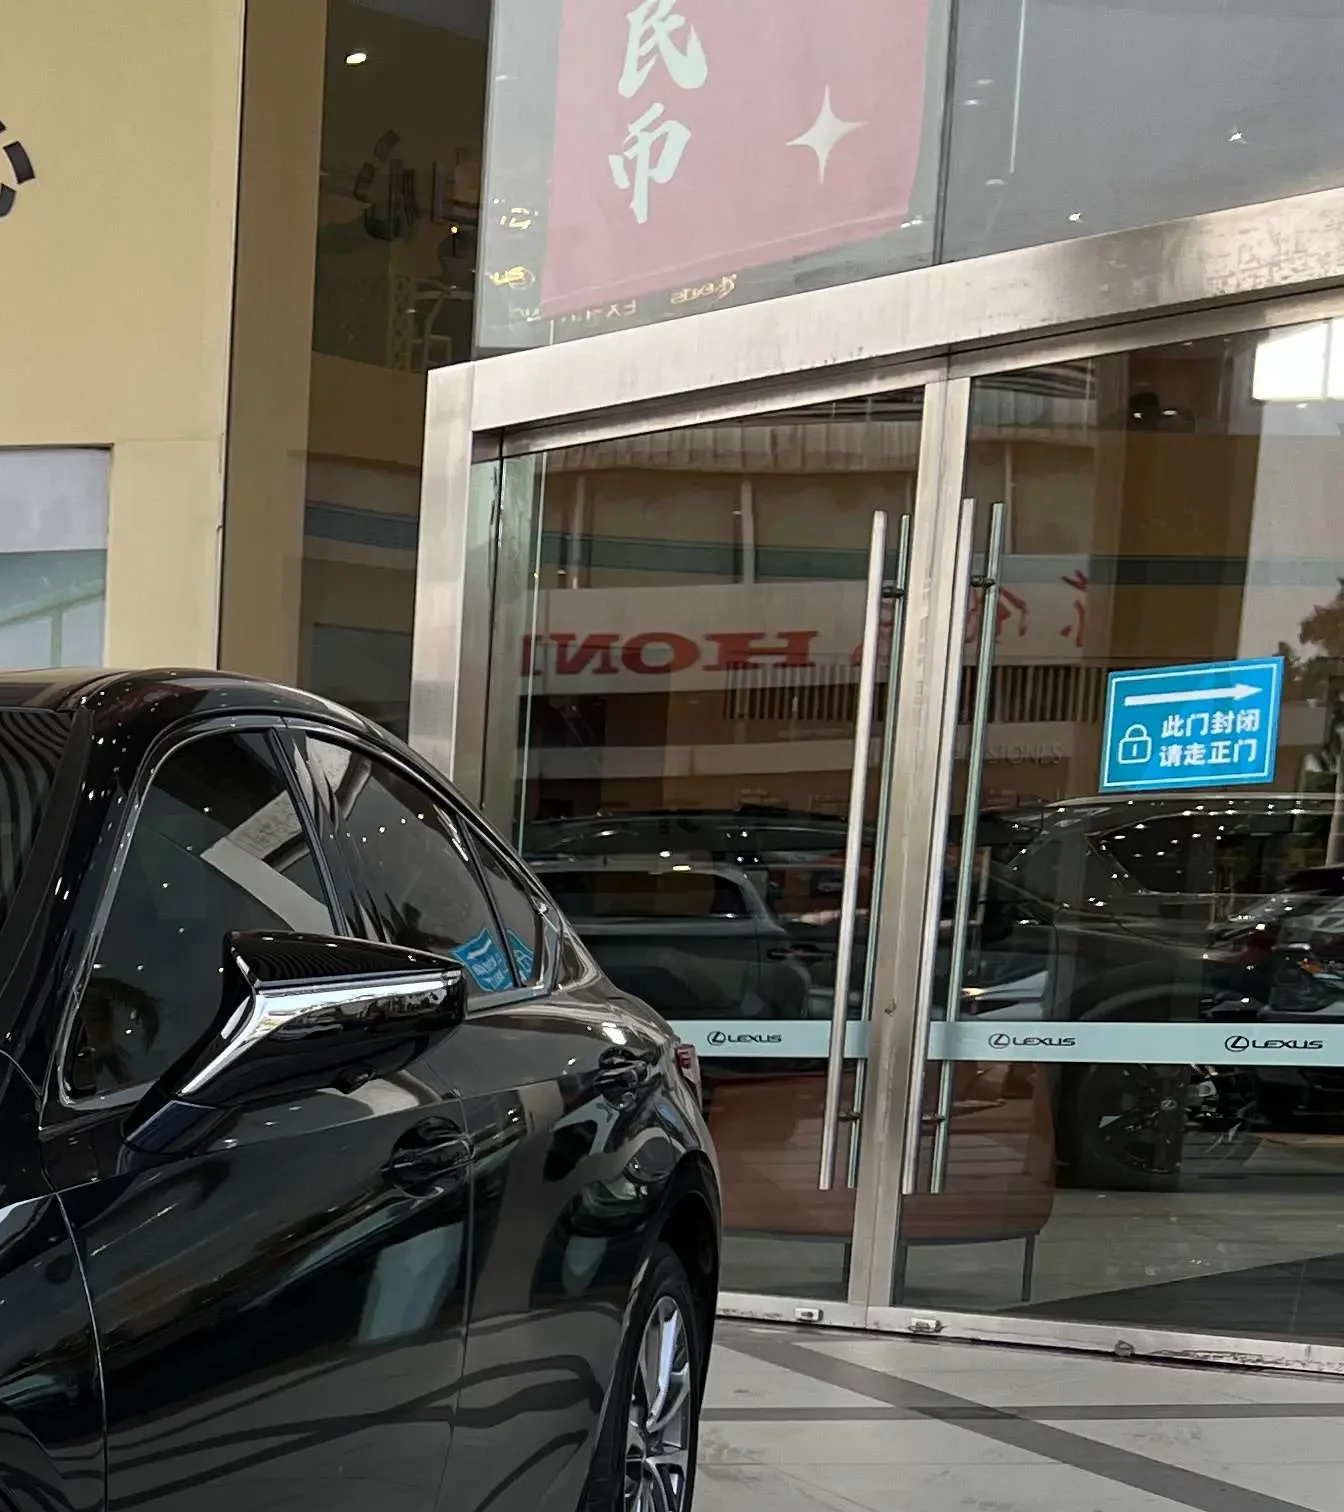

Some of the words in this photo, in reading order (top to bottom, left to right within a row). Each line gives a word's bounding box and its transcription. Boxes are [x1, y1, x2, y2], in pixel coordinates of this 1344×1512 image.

[1160, 708, 1261, 738] 此门封闭
[1158, 738, 1258, 768] 请走正门
[728, 1034, 782, 1044] LEXUS
[1013, 1037, 1076, 1047] LEXUS
[1252, 1039, 1324, 1050] LEXUS
